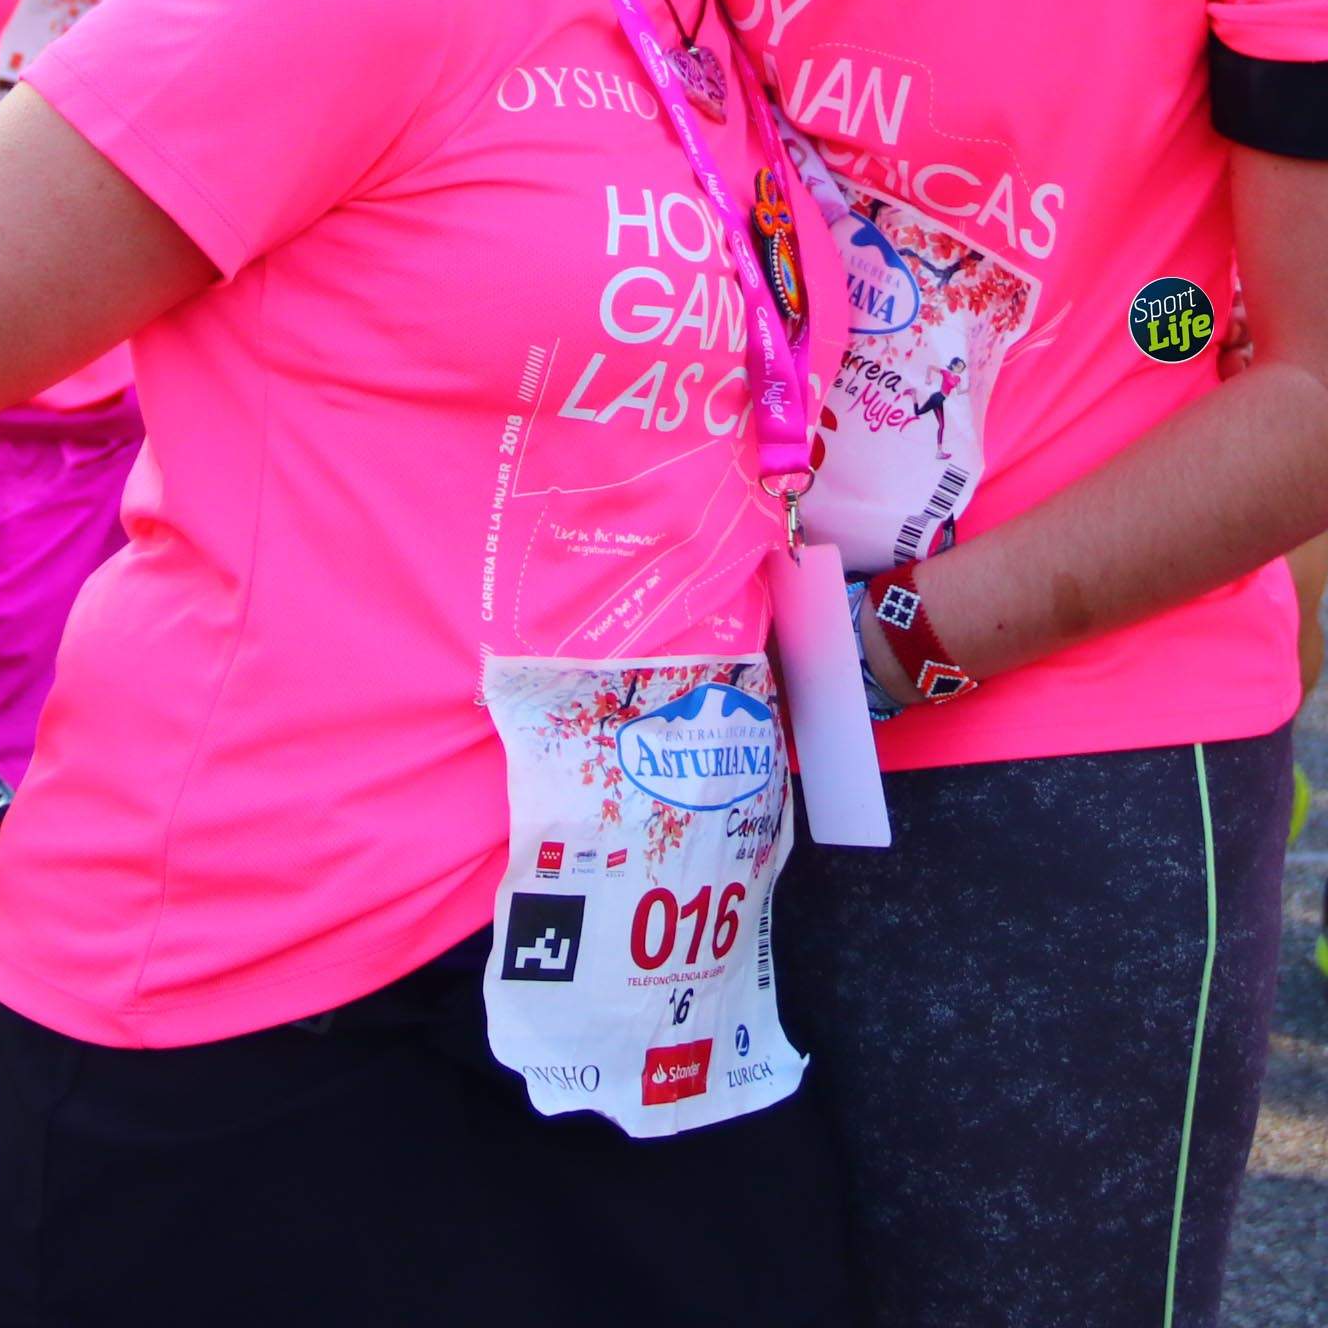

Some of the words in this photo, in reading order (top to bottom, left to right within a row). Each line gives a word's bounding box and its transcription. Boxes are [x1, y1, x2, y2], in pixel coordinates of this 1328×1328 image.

[497, 66, 659, 121] OYSHO
[604, 184, 731, 268] HOY
[598, 265, 746, 351] GAN
[1134, 286, 1198, 324] Sport
[1147, 308, 1213, 353] Life
[756, 306, 776, 363] Carrera
[558, 352, 703, 434] LAS
[761, 377, 792, 423] Mujer
[846, 381, 921, 433] Mujer
[499, 413, 524, 457] 2018
[494, 462, 513, 513] MUJER
[487, 530, 500, 556] DE
[491, 512, 502, 535] LA
[480, 555, 499, 622] CARRERA
[634, 733, 772, 779] ASTURIANA
[630, 881, 747, 971] 016
[727, 1061, 774, 1089] ZURICH
